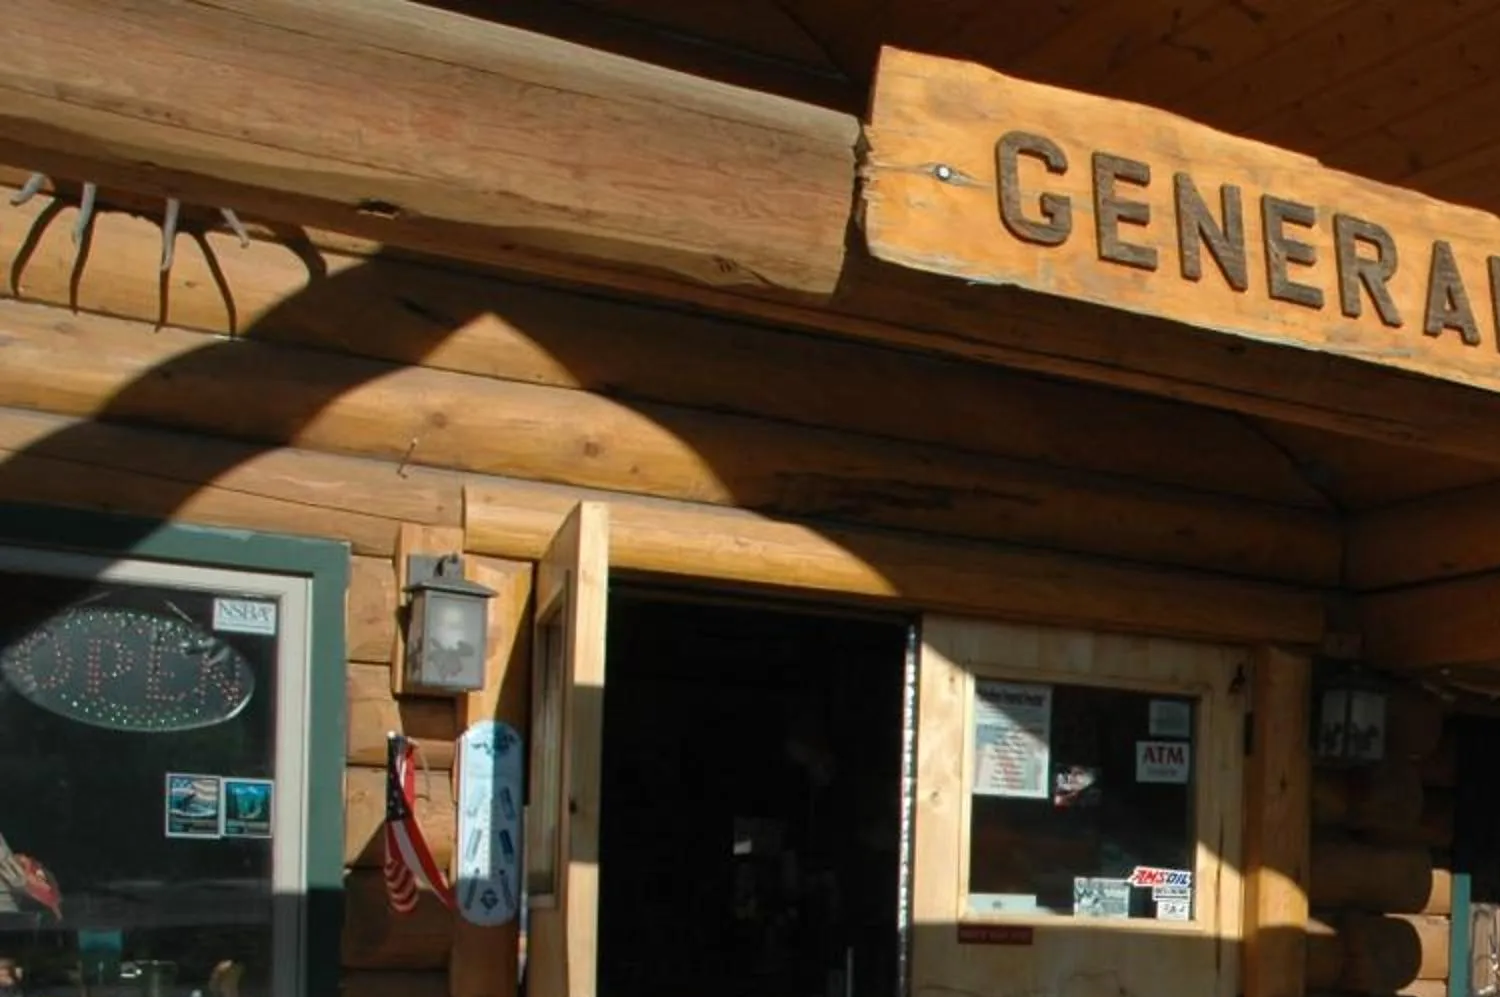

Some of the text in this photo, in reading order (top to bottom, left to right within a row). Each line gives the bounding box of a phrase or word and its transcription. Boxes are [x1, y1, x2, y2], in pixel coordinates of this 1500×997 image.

[14, 630, 242, 706] OPEN
[1142, 745, 1185, 765] ATM
[1134, 869, 1188, 885] AMSOIL
